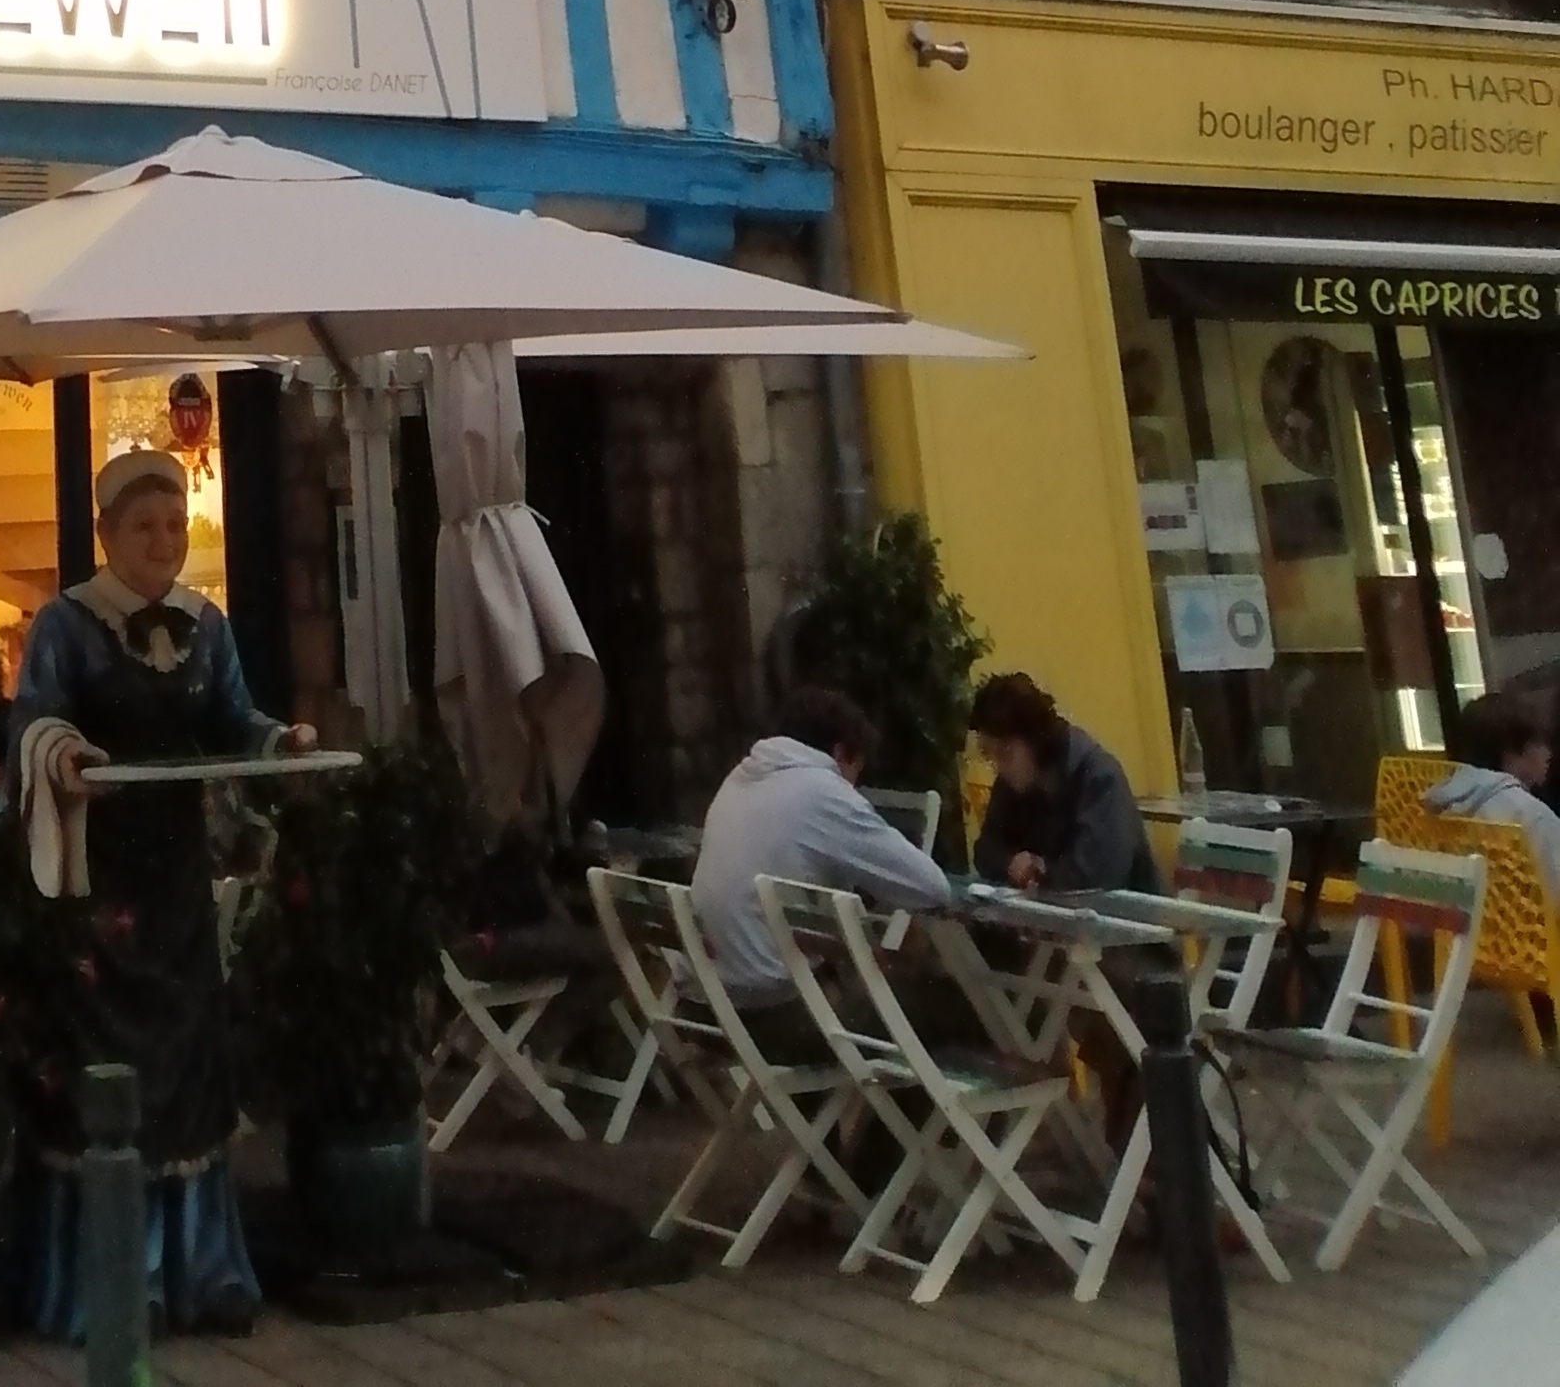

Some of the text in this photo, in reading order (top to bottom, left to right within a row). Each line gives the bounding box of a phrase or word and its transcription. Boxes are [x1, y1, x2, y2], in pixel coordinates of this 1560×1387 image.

[274, 68, 428, 95] Françoise DANET
[1382, 68, 1560, 107] Ph. HARD
[1198, 100, 1376, 154] boulanger
[1409, 118, 1549, 158] patissier
[1294, 277, 1359, 316] LES
[1370, 277, 1542, 321] CAPRICES
